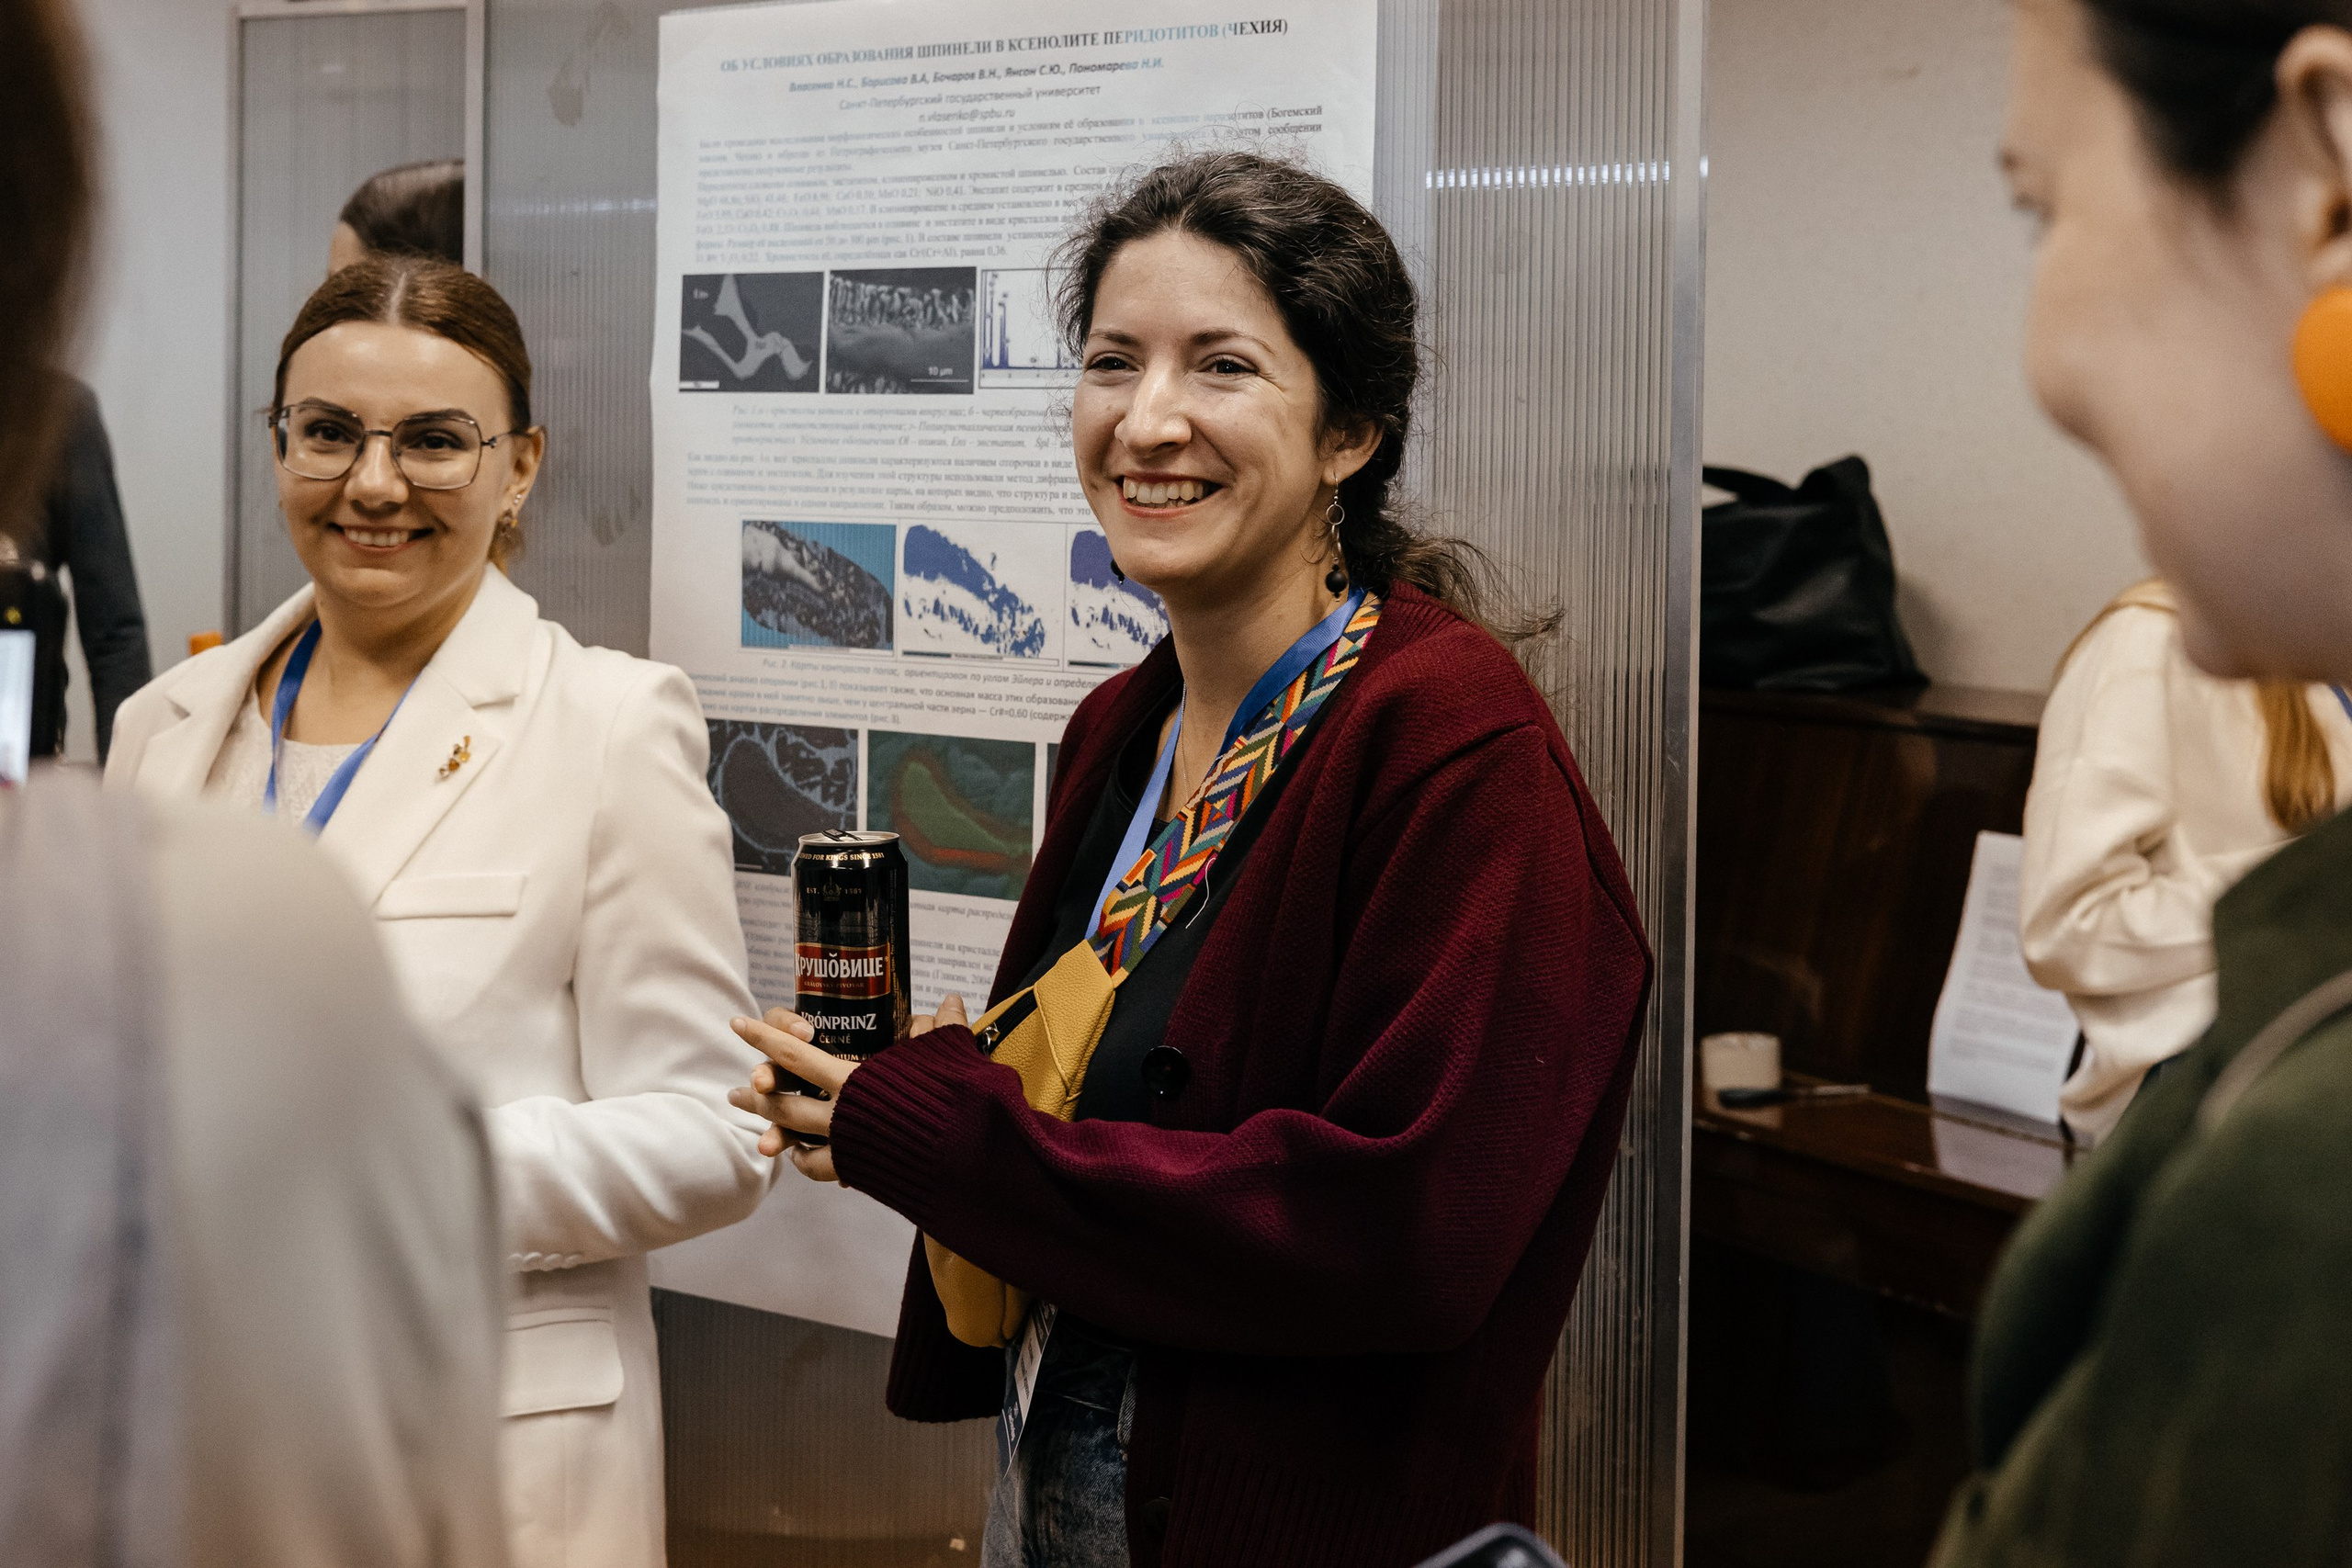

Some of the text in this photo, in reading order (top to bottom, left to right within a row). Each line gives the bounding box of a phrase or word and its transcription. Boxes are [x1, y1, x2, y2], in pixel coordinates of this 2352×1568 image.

[720, 17, 1288, 72] ОБ УСЛОВИЯХ ОБРАЗОВАНИЯ ШПИНЕЛИ В КСЕНОЛИТЕ ПЕРИДОТИТОВ (ЧЕХИЯ)
[933, 71, 976, 83] Бочаров
[978, 68, 1001, 80] В.Н.,
[1005, 66, 1036, 78] Янсон
[1039, 63, 1065, 75] С.Ю.,
[1069, 60, 1138, 76] Пономарева
[1141, 57, 1164, 70] Н.И.
[944, 89, 1032, 105] государственный
[1035, 85, 1101, 101] университет
[1266, 104, 1323, 121] (Богемский
[1268, 123, 1322, 137] сообщении
[1073, 164, 1106, 175] Состав
[999, 459, 1040, 470] оторочки
[899, 472, 942, 484] структуры
[1007, 475, 1033, 485] метод
[997, 491, 1012, 499] что
[1014, 491, 1059, 504] структура
[956, 504, 986, 513] можно
[1058, 508, 1074, 516] что
[1077, 509, 1091, 518] это
[904, 669, 968, 682] ориентировок
[970, 672, 981, 682] по
[1012, 672, 1044, 687] Эйлера
[920, 686, 933, 696] что
[935, 688, 975, 700] основная
[978, 693, 1002, 702] масса
[1005, 694, 1023, 703] этих
[926, 702, 949, 713] части
[952, 705, 976, 716] зерна
[813, 852, 824, 861] FOR
[825, 853, 848, 862] KINGS
[850, 853, 871, 862] SINCE
[806, 886, 820, 895] EST.
[820, 1032, 851, 1044] ČERNÉ
